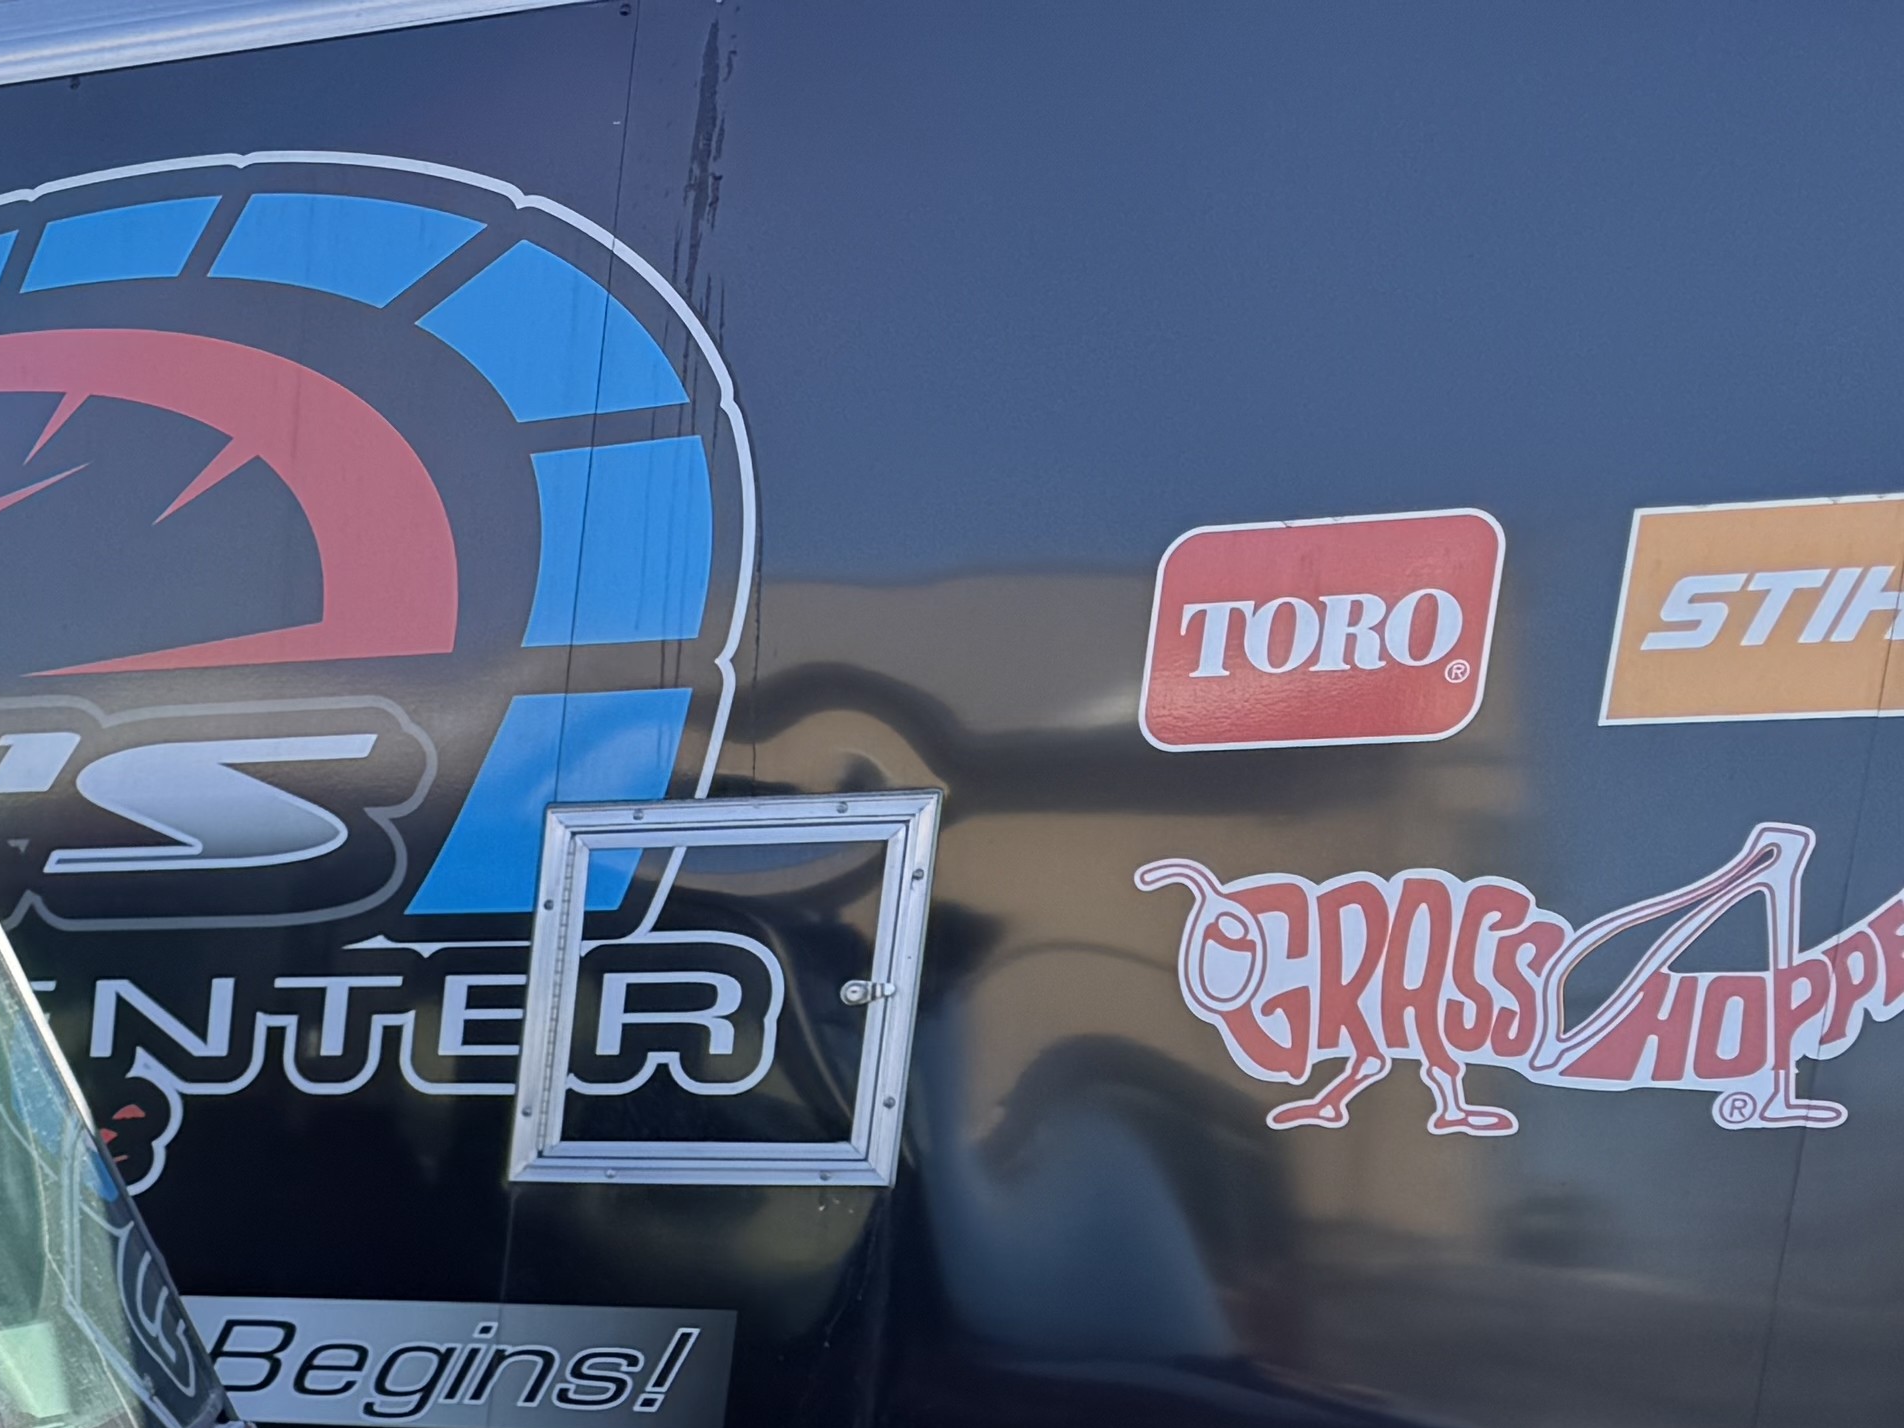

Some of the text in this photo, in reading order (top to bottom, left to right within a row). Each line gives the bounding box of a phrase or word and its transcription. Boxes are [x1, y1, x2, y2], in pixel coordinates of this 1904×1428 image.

[1180, 588, 1463, 678] TORO
[1640, 565, 1904, 651] STIH
[1197, 876, 1904, 1083] GRASSHOPPE
[209, 1316, 702, 1422] Begins!
